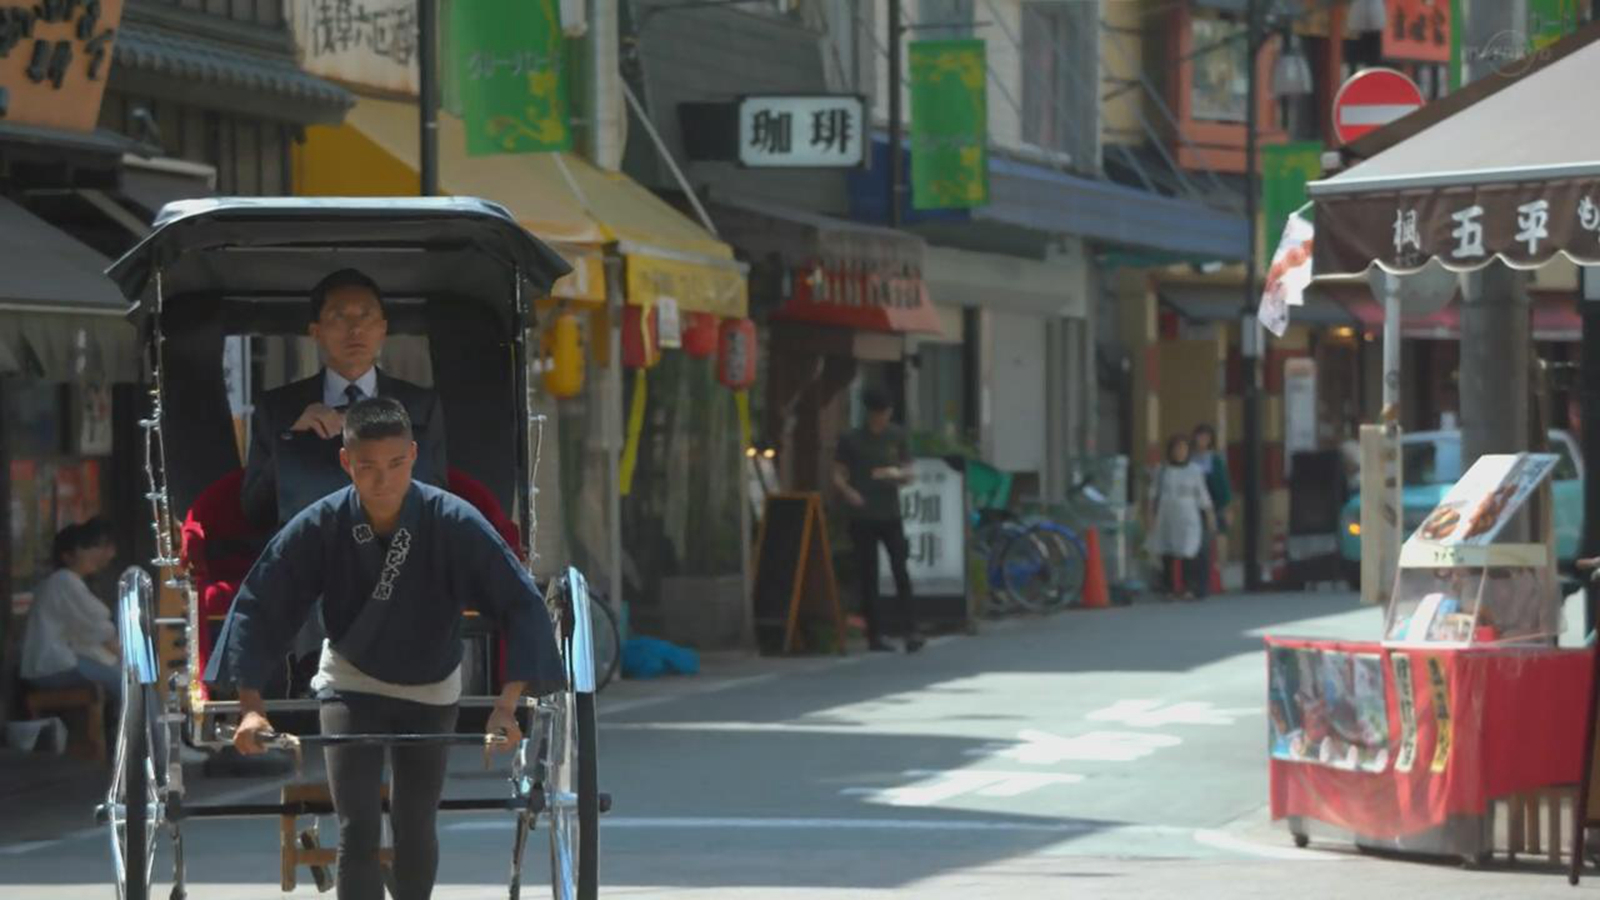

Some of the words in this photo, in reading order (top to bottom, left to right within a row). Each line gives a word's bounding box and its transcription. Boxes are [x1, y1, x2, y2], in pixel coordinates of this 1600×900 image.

[750, 108, 852, 155] 珈琲
[1392, 195, 1600, 258] 楓五平も
